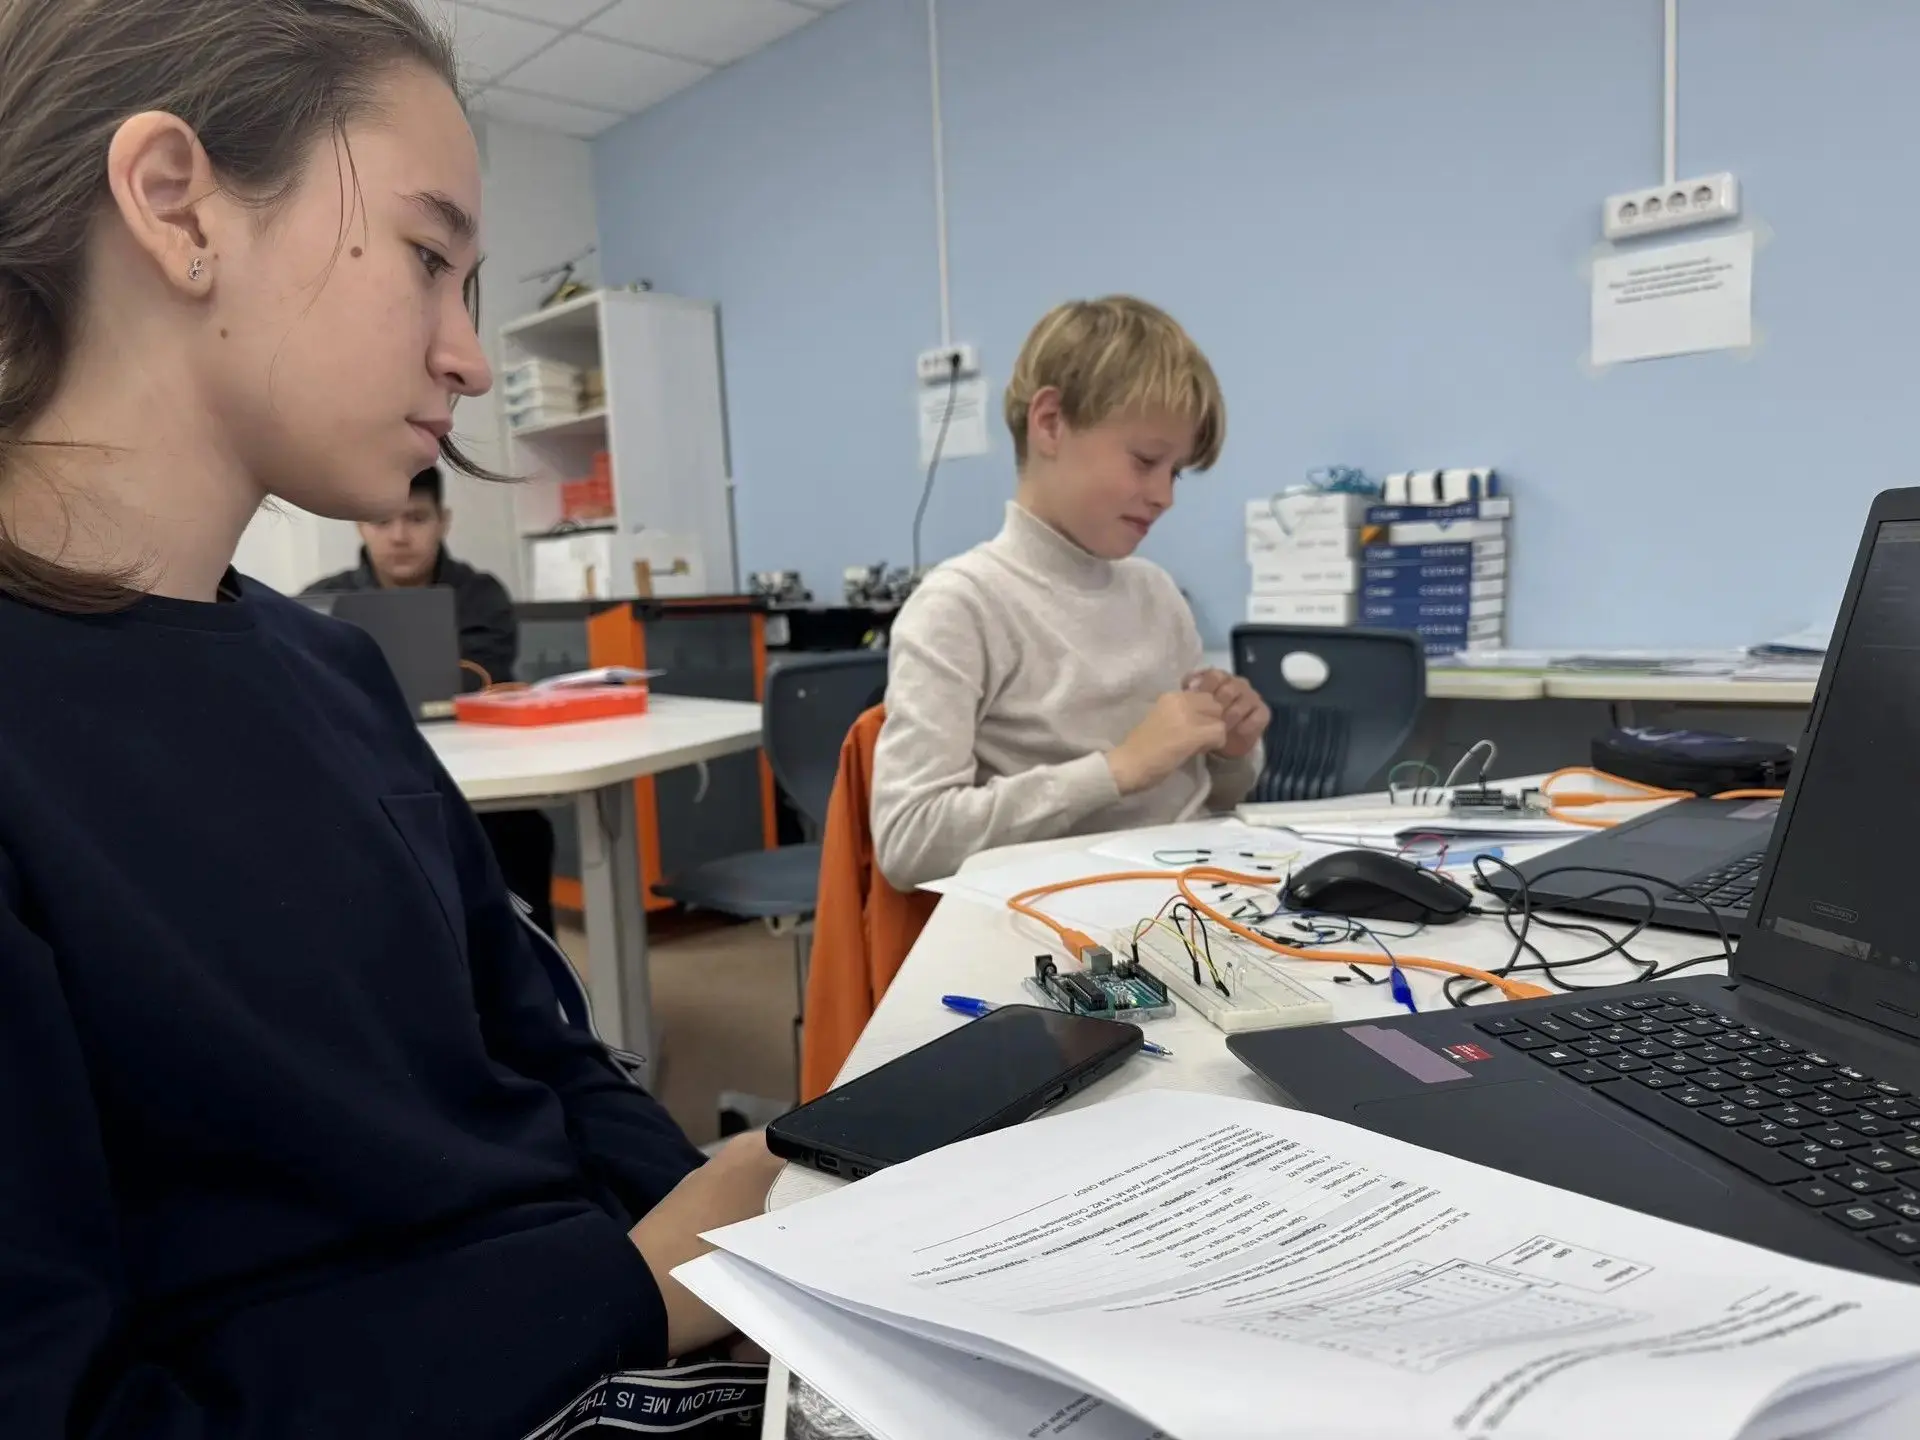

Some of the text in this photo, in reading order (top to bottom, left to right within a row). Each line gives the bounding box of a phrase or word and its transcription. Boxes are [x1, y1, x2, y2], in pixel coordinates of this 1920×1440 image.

[576, 1388, 746, 1417] FELLOW ME IS THE
